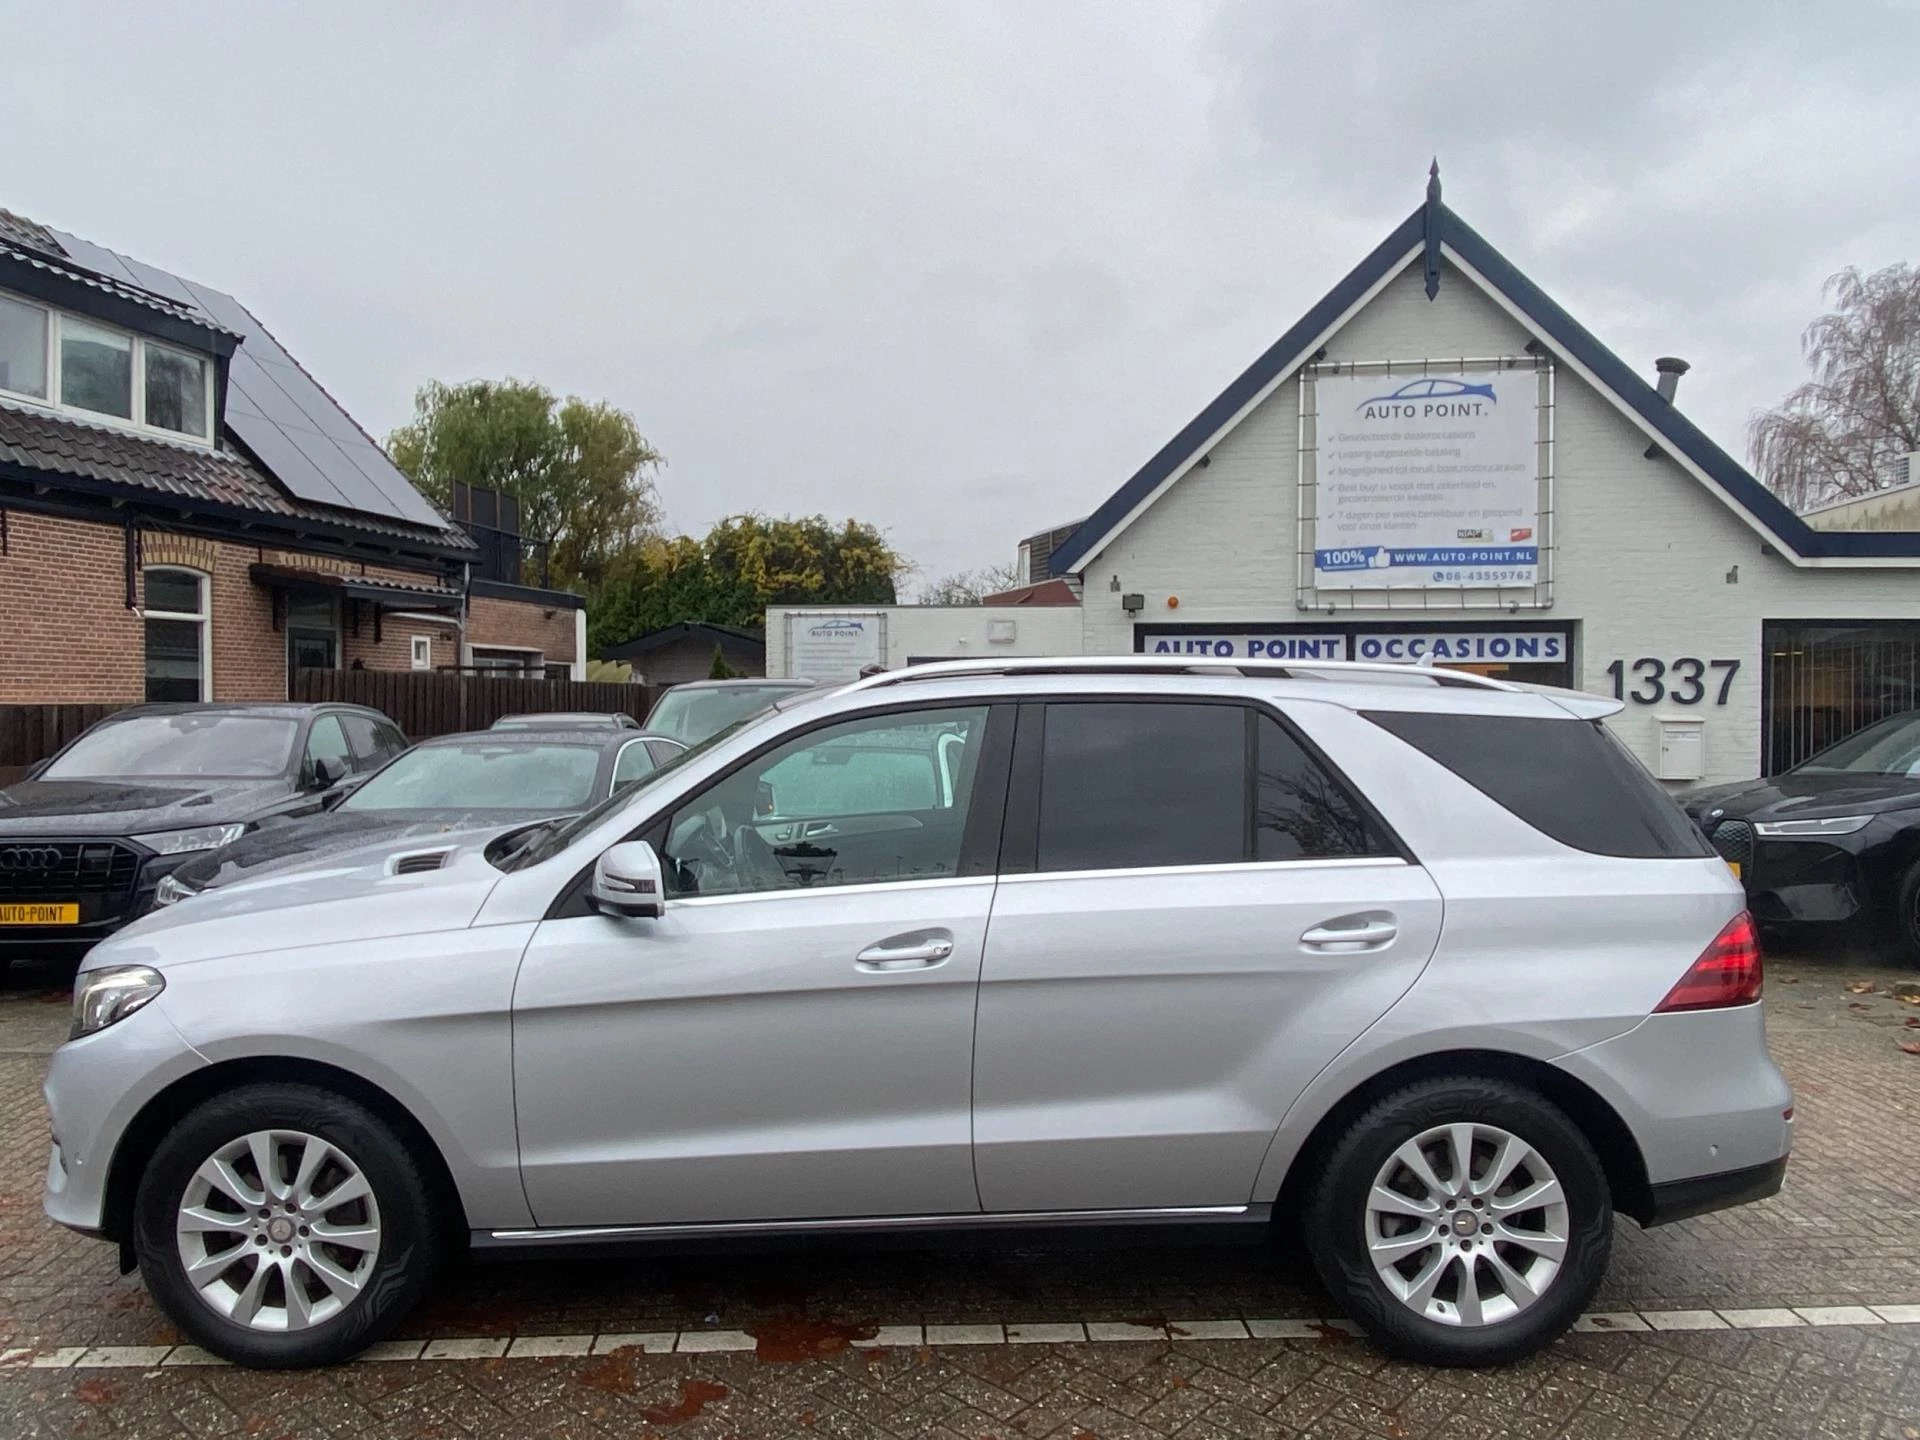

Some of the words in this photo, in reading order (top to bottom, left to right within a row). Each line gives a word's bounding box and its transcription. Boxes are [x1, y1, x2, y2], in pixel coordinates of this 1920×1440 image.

[1365, 404, 1416, 420] AUTO
[1324, 550, 1365, 565] 100%
[1394, 551, 1533, 563] WWW.AUTO-POINT.NL
[1155, 640, 1234, 658] AUTO
[1248, 639, 1340, 659] POINT
[1361, 637, 1560, 658] OCCASIONS
[1607, 657, 1741, 705] 1337
